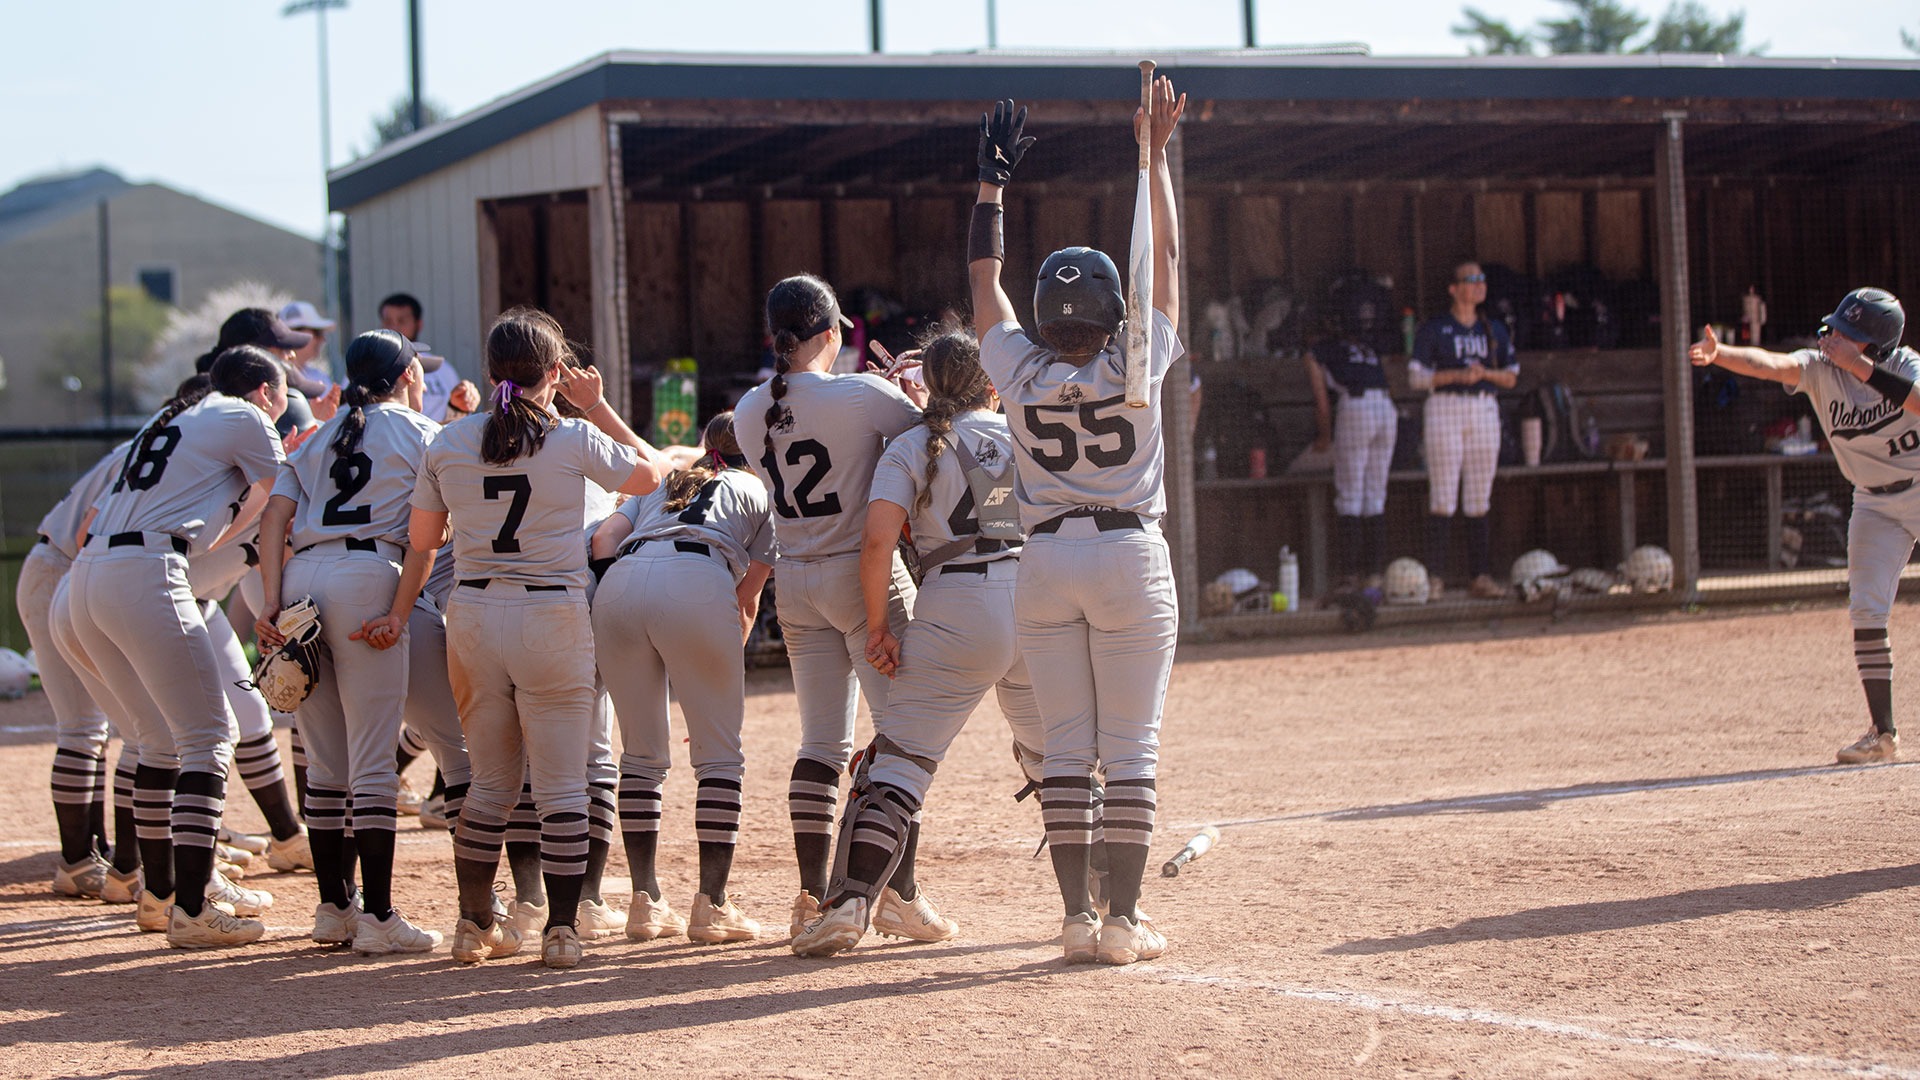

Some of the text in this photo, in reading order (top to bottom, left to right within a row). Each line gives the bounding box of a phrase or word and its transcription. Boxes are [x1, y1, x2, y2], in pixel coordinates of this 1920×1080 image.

[1063, 303, 1072, 315] 55
[1453, 333, 1489, 360] FDU
[111, 425, 182, 495] 18
[1023, 393, 1137, 472] 55
[1885, 429, 1920, 457] 10
[322, 451, 373, 526] 2
[760, 438, 843, 518] 12
[983, 487, 1014, 507] AF
[483, 474, 532, 553] 7
